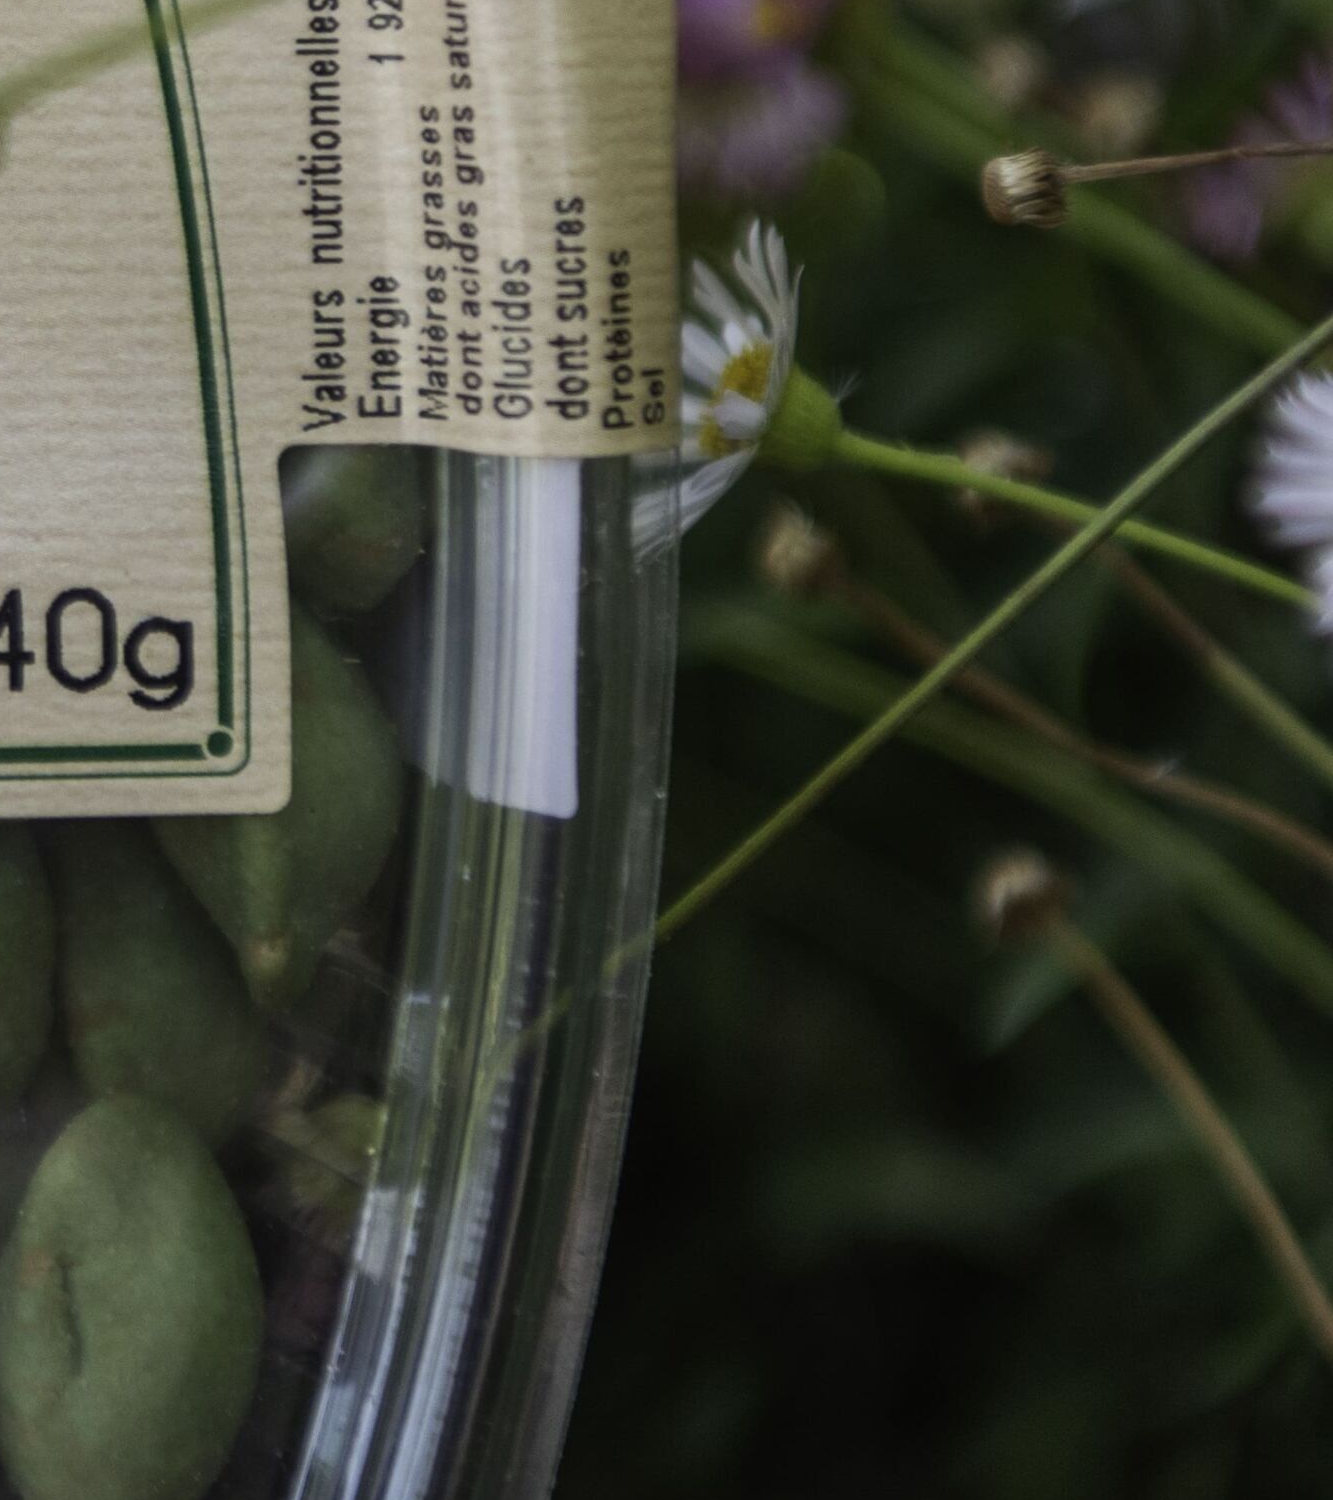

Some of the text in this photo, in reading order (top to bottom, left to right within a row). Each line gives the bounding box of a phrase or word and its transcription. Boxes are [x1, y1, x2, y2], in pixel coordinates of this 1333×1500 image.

[419, 105, 453, 250] grasses
[452, 105, 484, 185] gras
[450, 200, 481, 318] acides
[553, 197, 585, 322] sucres
[302, 289, 346, 432] Valeurs
[358, 276, 409, 418] Energie
[418, 265, 450, 421] Matières
[456, 330, 482, 415] dont
[491, 258, 534, 419] Glucides
[546, 334, 590, 421] dont
[642, 368, 665, 425] Sel
